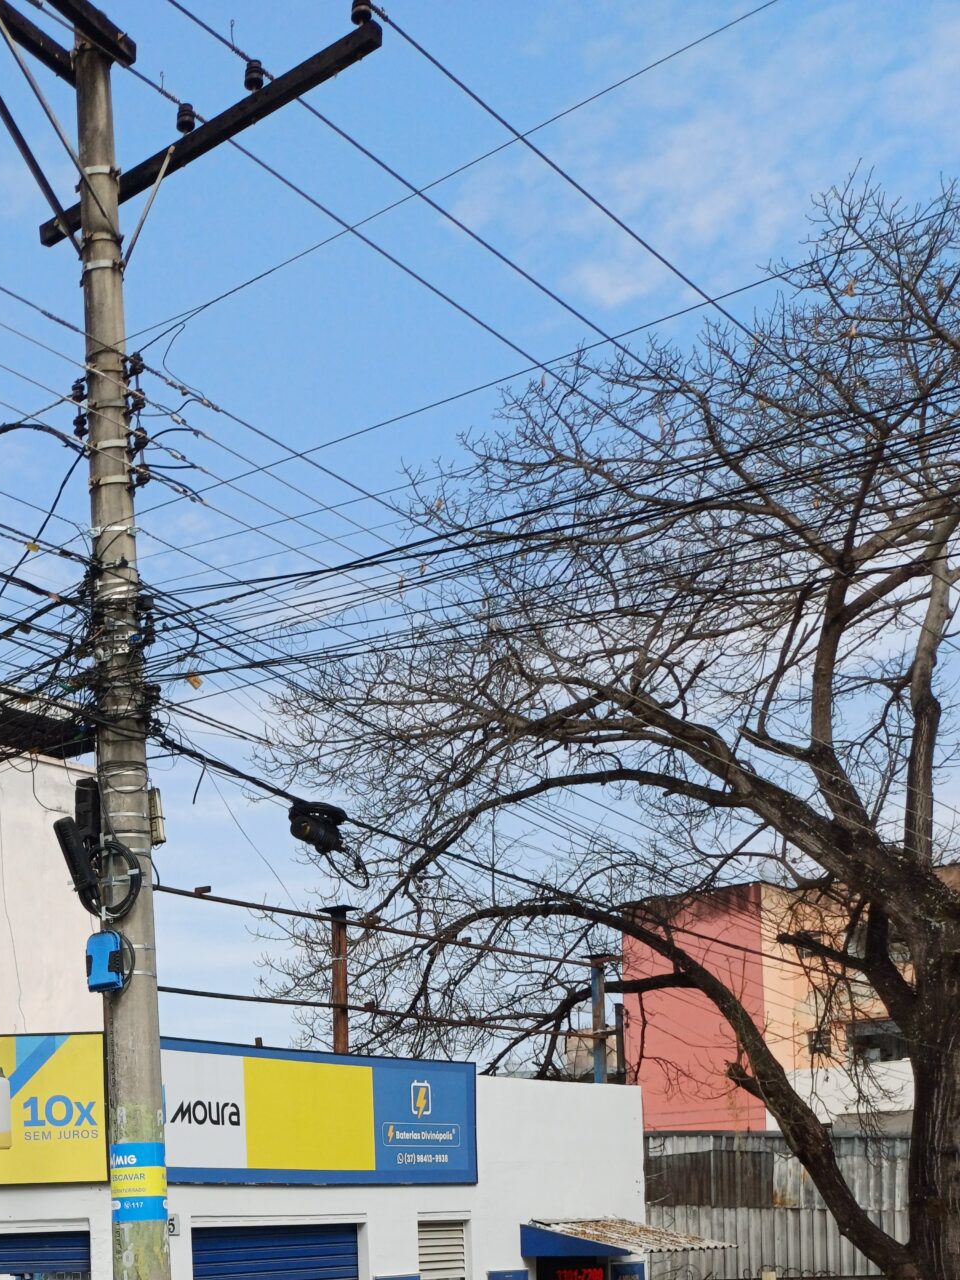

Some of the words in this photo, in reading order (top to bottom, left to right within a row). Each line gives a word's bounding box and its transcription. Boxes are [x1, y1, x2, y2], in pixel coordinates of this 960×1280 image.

[23, 1095, 98, 1127] 10x
[24, 1131, 52, 1141] SEM
[57, 1129, 99, 1140] JUROS
[395, 1130, 421, 1140] Baterias
[111, 1154, 137, 1166] MIG
[404, 1153, 416, 1164] (37)
